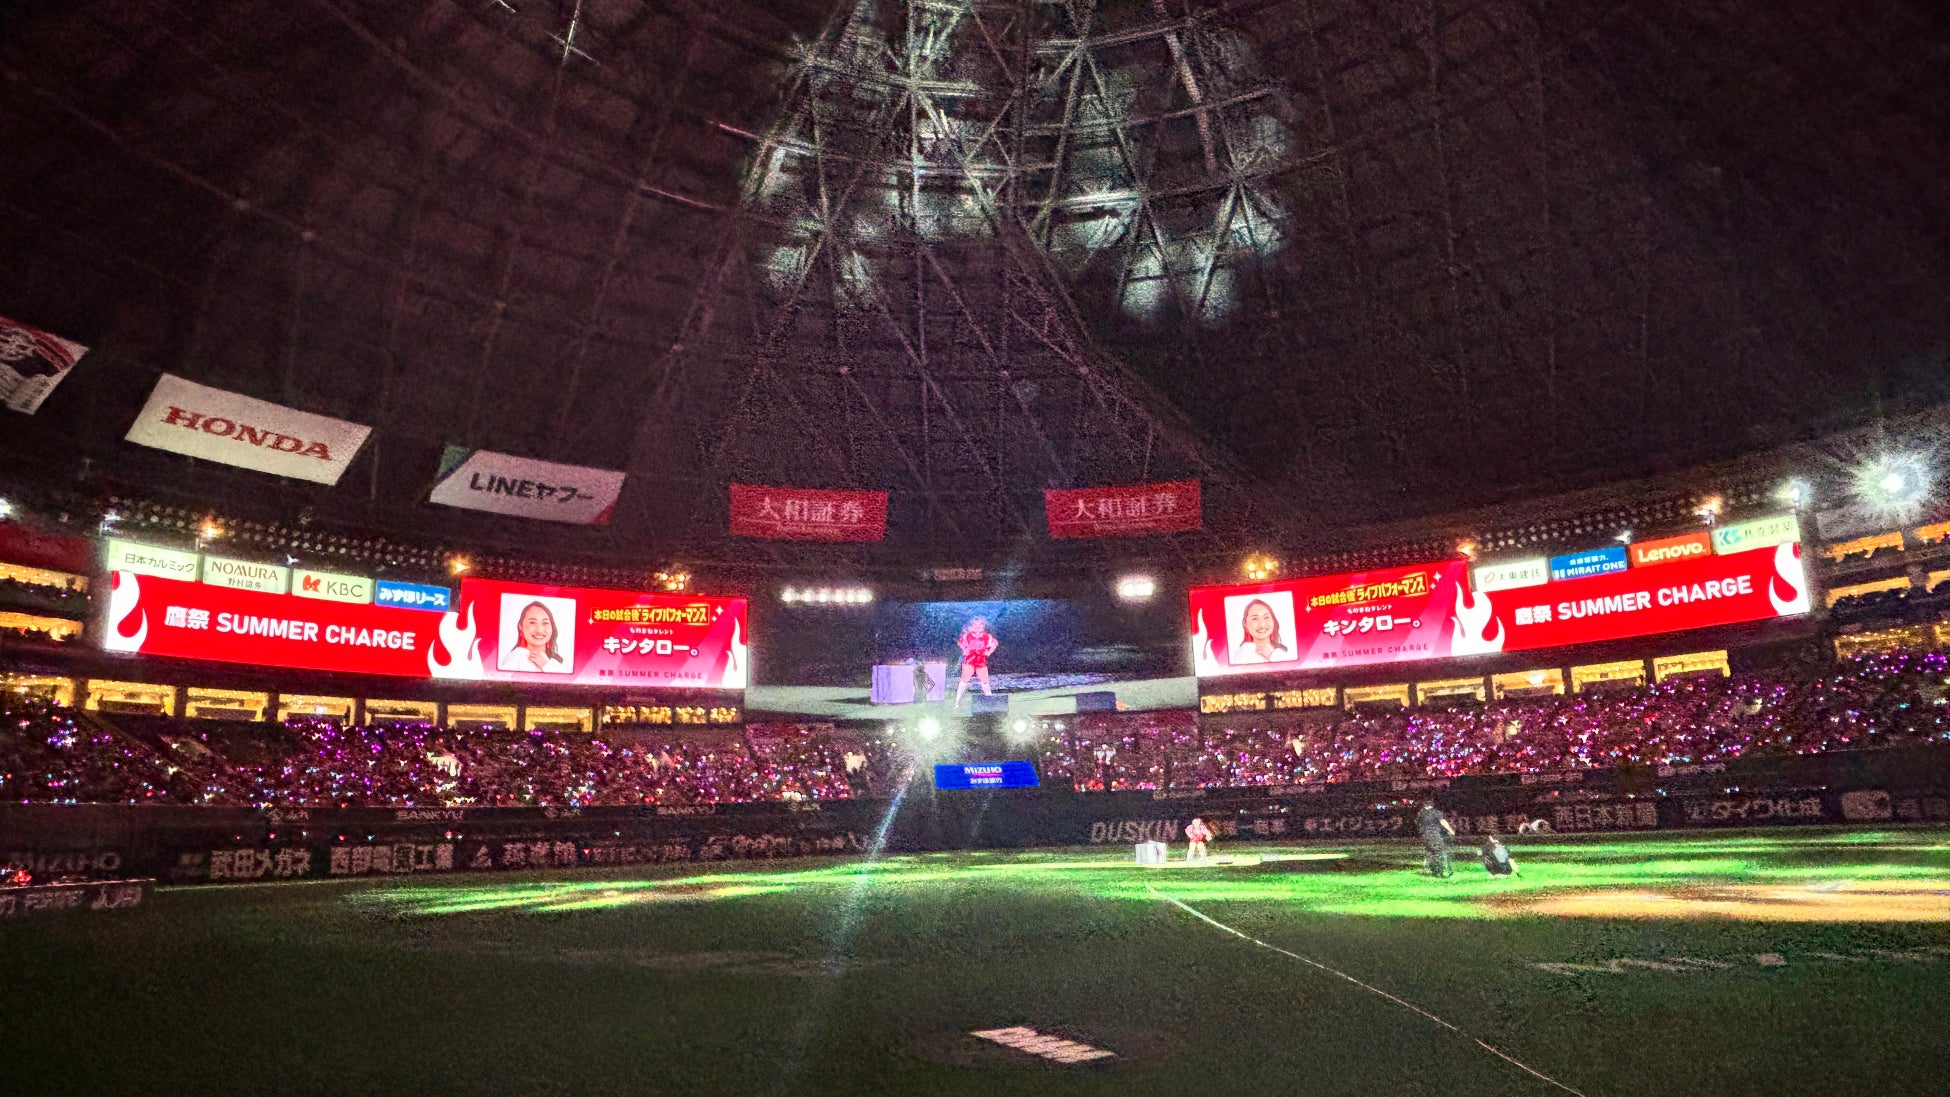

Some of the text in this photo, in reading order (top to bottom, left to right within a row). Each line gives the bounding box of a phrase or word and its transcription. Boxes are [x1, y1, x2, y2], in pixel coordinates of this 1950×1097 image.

[161, 406, 333, 461] HONDA
[470, 473, 594, 502] LINEヤフー
[125, 553, 195, 573] 日本カルミック
[1638, 541, 1703, 563] Lenovo
[211, 561, 279, 581] NOMURA
[326, 580, 363, 598] KBC
[1557, 591, 1652, 620] SUMMER
[1657, 575, 1753, 607] CHARGE
[216, 612, 318, 642] SUMMER
[325, 625, 416, 650] CHARGE
[1323, 615, 1421, 637] キンタロー。
[603, 636, 699, 656] キンタロー。
[1342, 647, 1383, 658] SUMMER
[1387, 642, 1429, 653] CHARGE
[618, 670, 659, 678] SUMMER
[664, 671, 703, 680] CHARGE
[1091, 819, 1179, 843] DUSKIN
